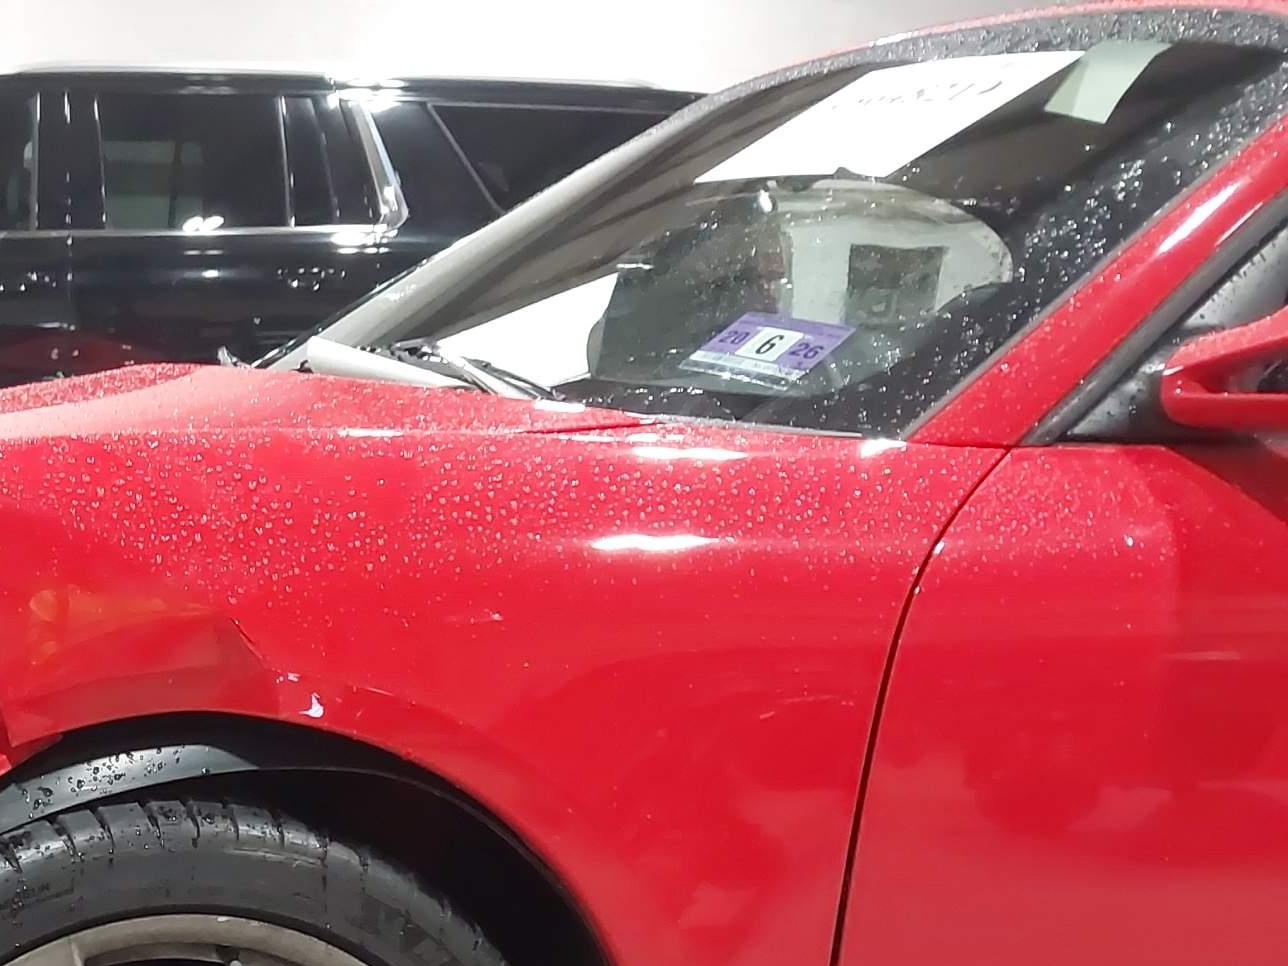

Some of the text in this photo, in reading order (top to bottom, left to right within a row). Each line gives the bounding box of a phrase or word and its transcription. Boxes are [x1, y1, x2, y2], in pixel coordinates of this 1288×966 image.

[718, 330, 824, 360] 20 6 26
